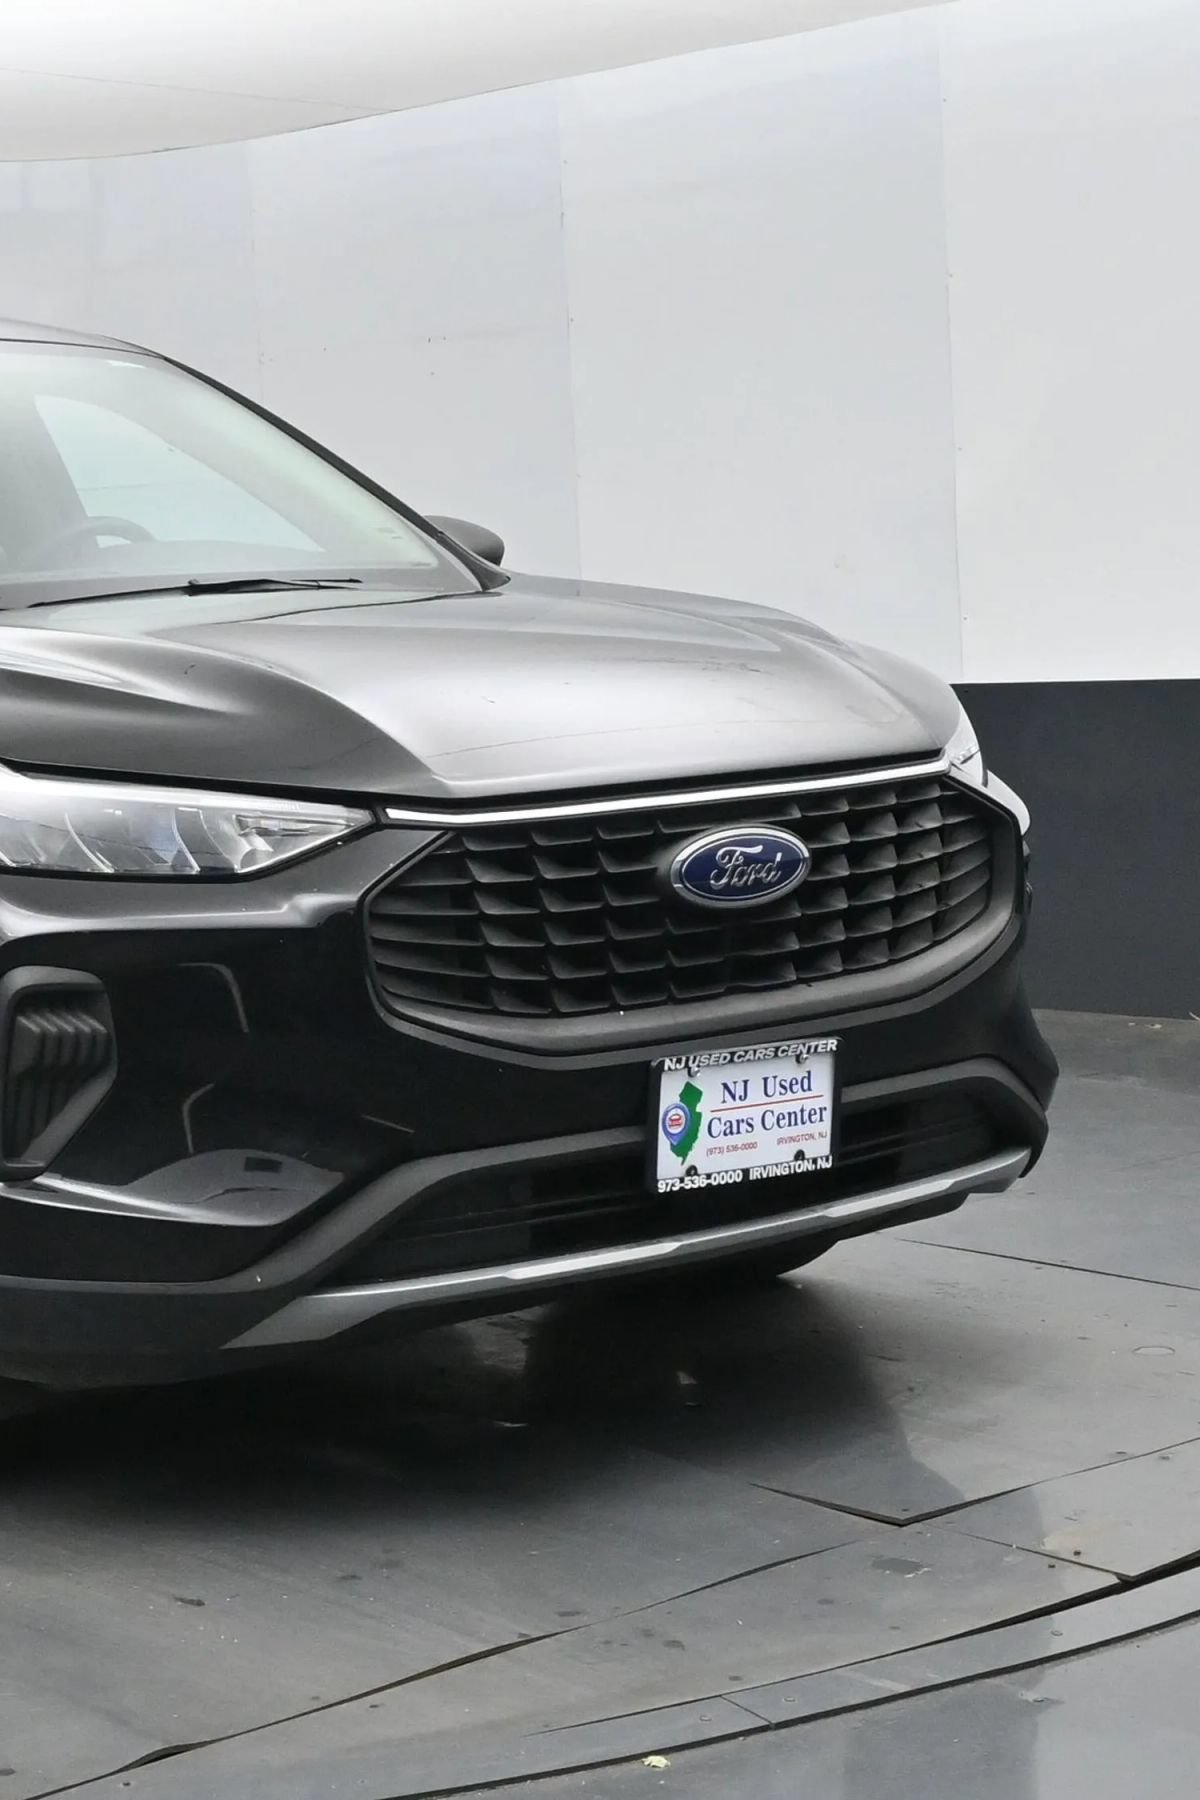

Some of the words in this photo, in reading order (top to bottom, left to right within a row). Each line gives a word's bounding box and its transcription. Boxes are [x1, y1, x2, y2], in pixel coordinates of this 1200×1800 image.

[710, 845, 782, 889] Ford
[664, 1057, 686, 1071] NJ
[688, 1053, 731, 1068] USED
[733, 1047, 775, 1063] CARS
[777, 1039, 838, 1057] CENTER
[721, 1079, 750, 1104] NJ
[762, 1070, 813, 1098] Used
[707, 1117, 755, 1139] Cars
[760, 1104, 827, 1131] Center
[817, 1131, 828, 1139] NJ
[817, 1155, 833, 1168] NJ
[658, 1170, 743, 1193] 973-536-0000
